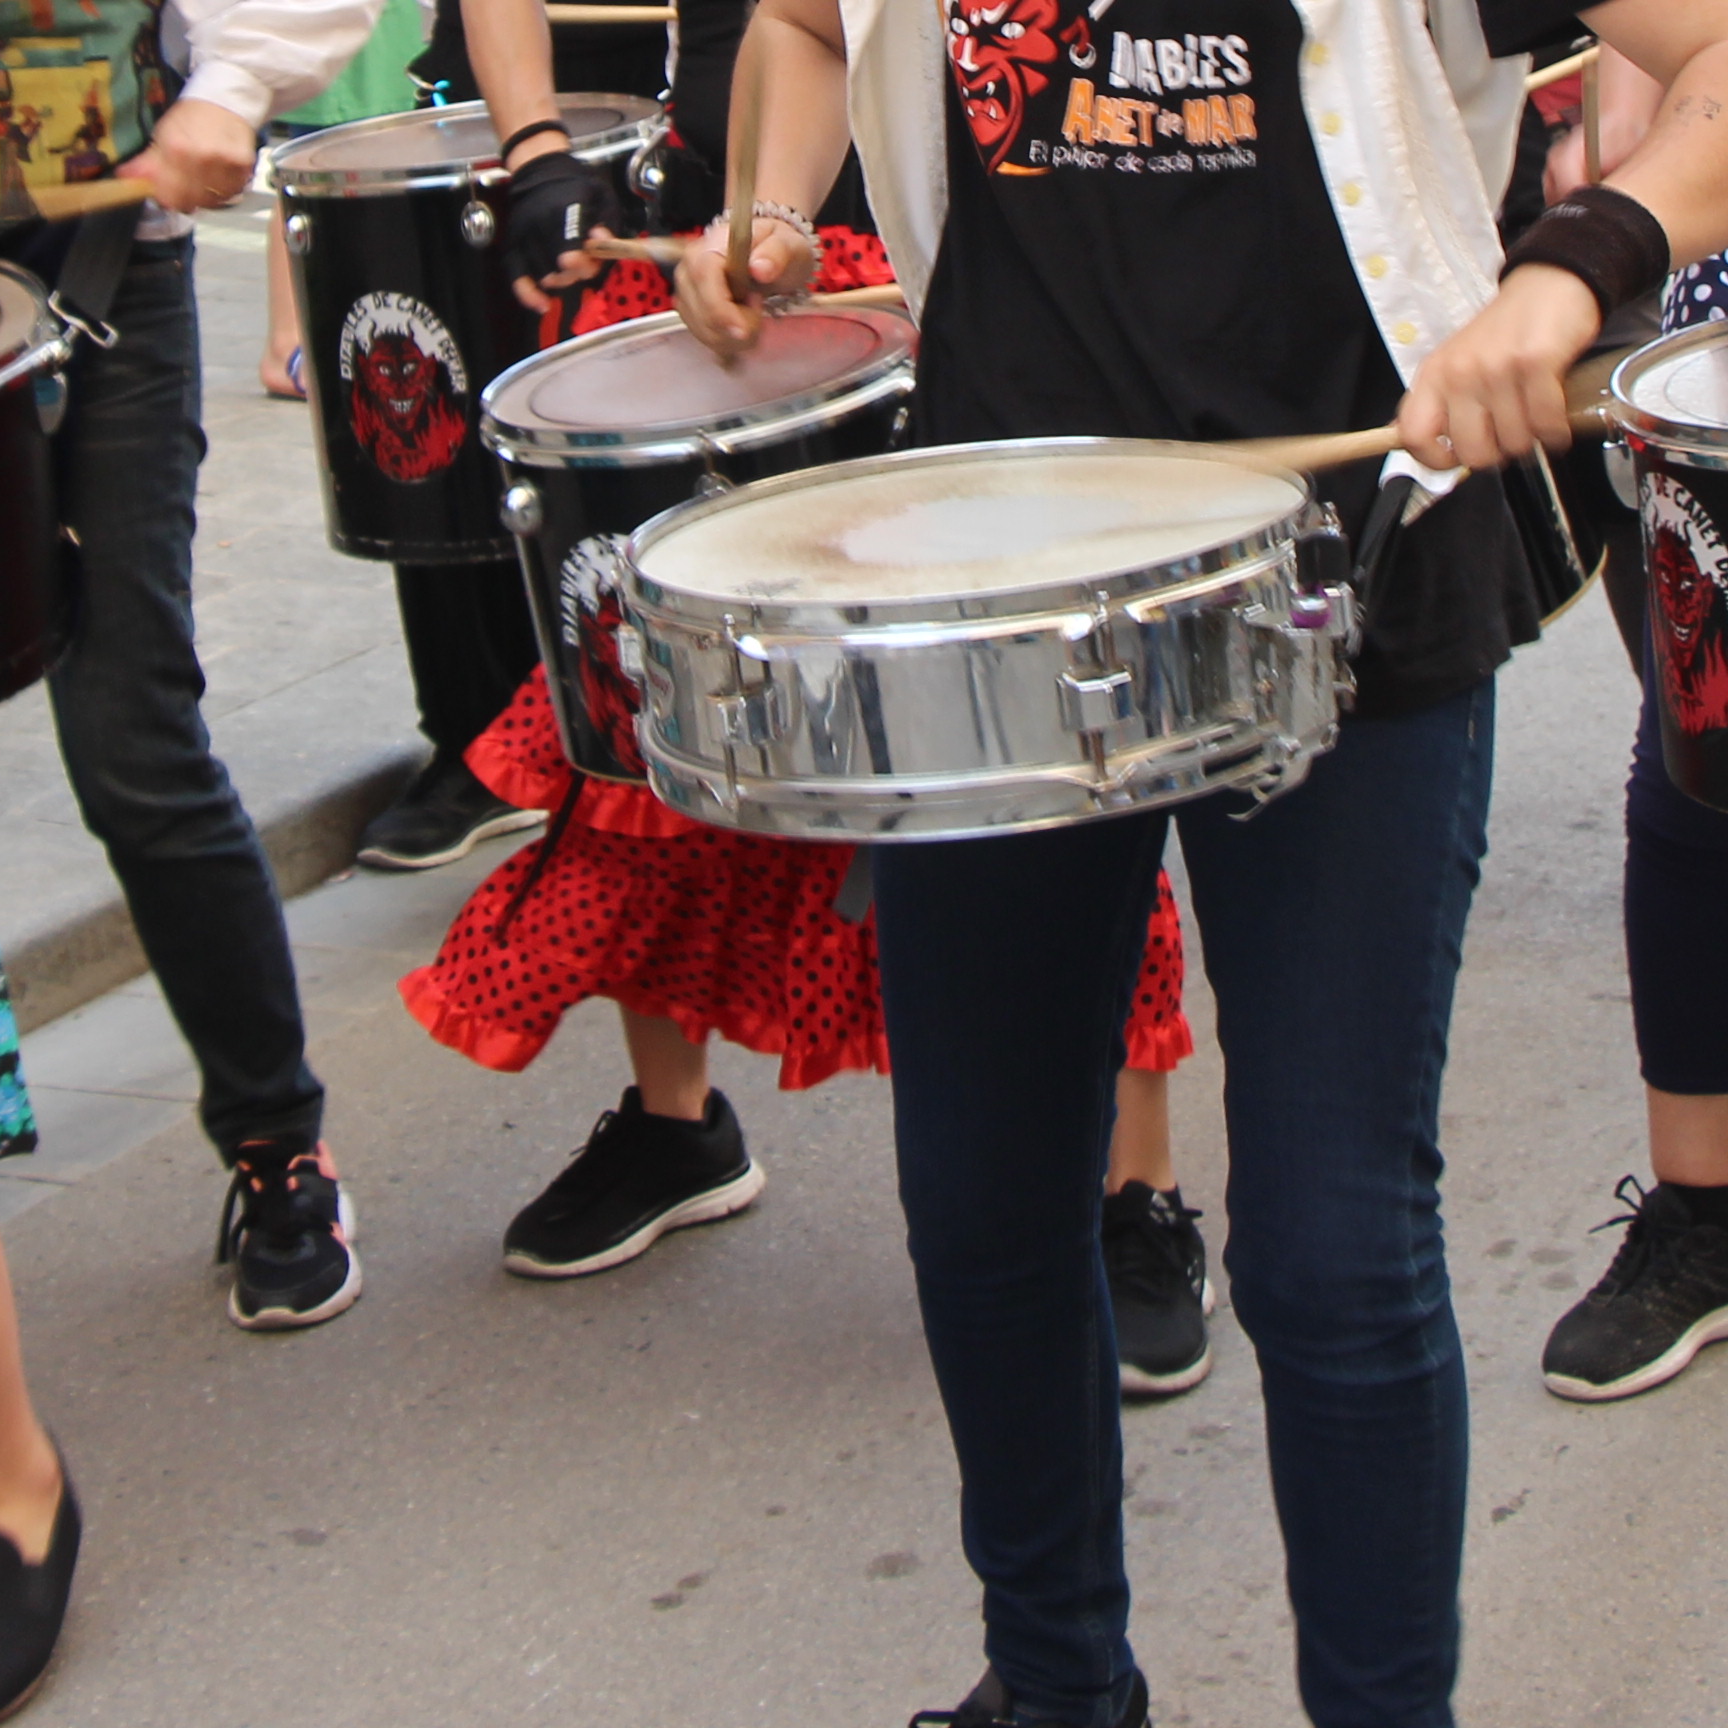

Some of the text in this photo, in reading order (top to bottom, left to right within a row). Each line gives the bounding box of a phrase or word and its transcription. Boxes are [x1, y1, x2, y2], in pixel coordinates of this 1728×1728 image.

[371, 290, 391, 310] DE
[397, 293, 443, 334] CANET
[1674, 485, 1724, 551] CANET
